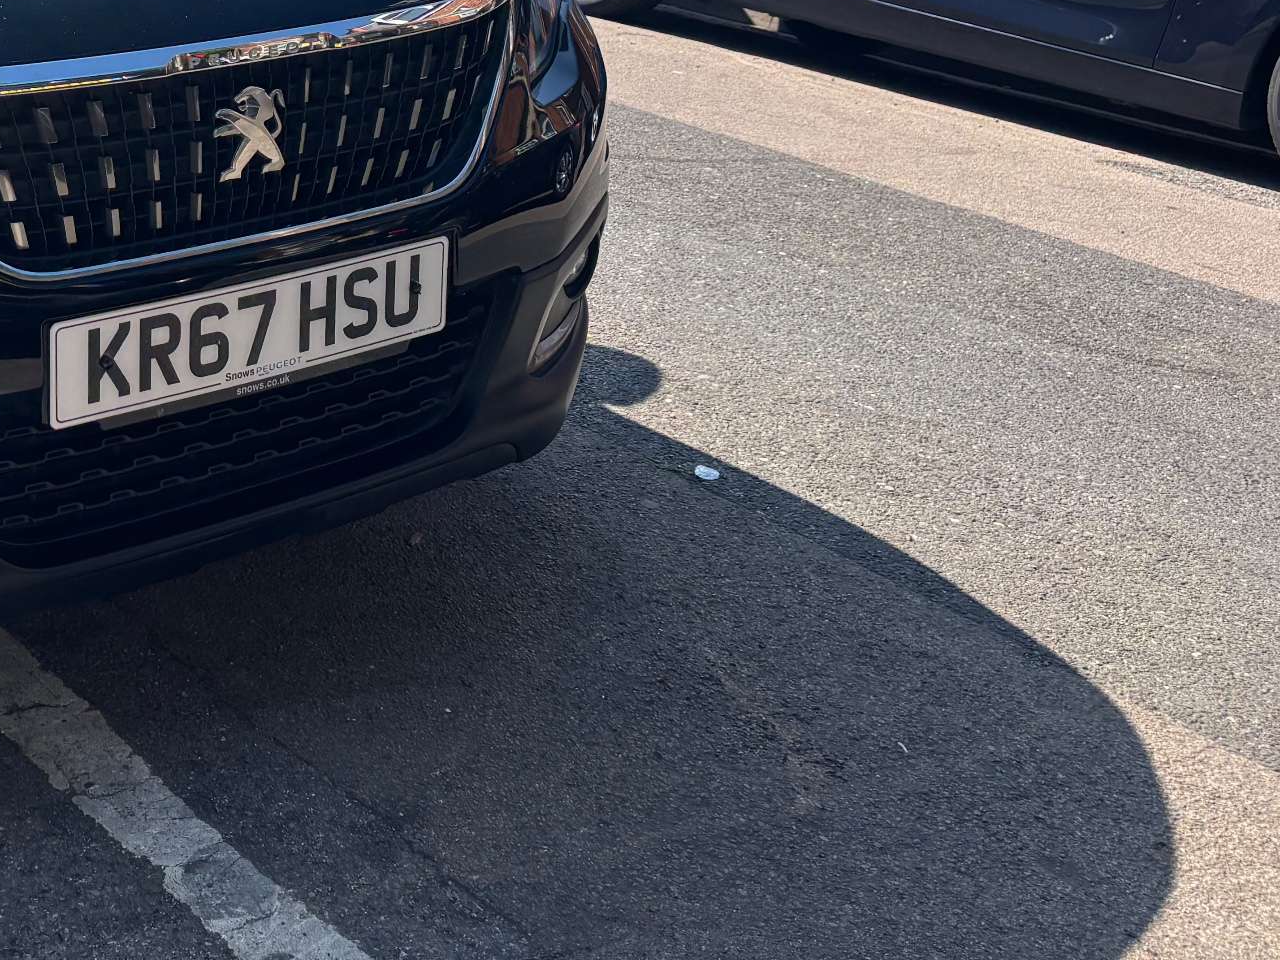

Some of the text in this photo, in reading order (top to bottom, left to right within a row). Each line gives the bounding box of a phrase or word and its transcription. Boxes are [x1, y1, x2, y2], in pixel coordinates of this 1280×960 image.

[87, 253, 422, 405] KR67 HSU
[225, 368, 255, 382] Snows
[256, 356, 303, 374] PEUGEOT
[236, 373, 291, 396] snows.co.uk
